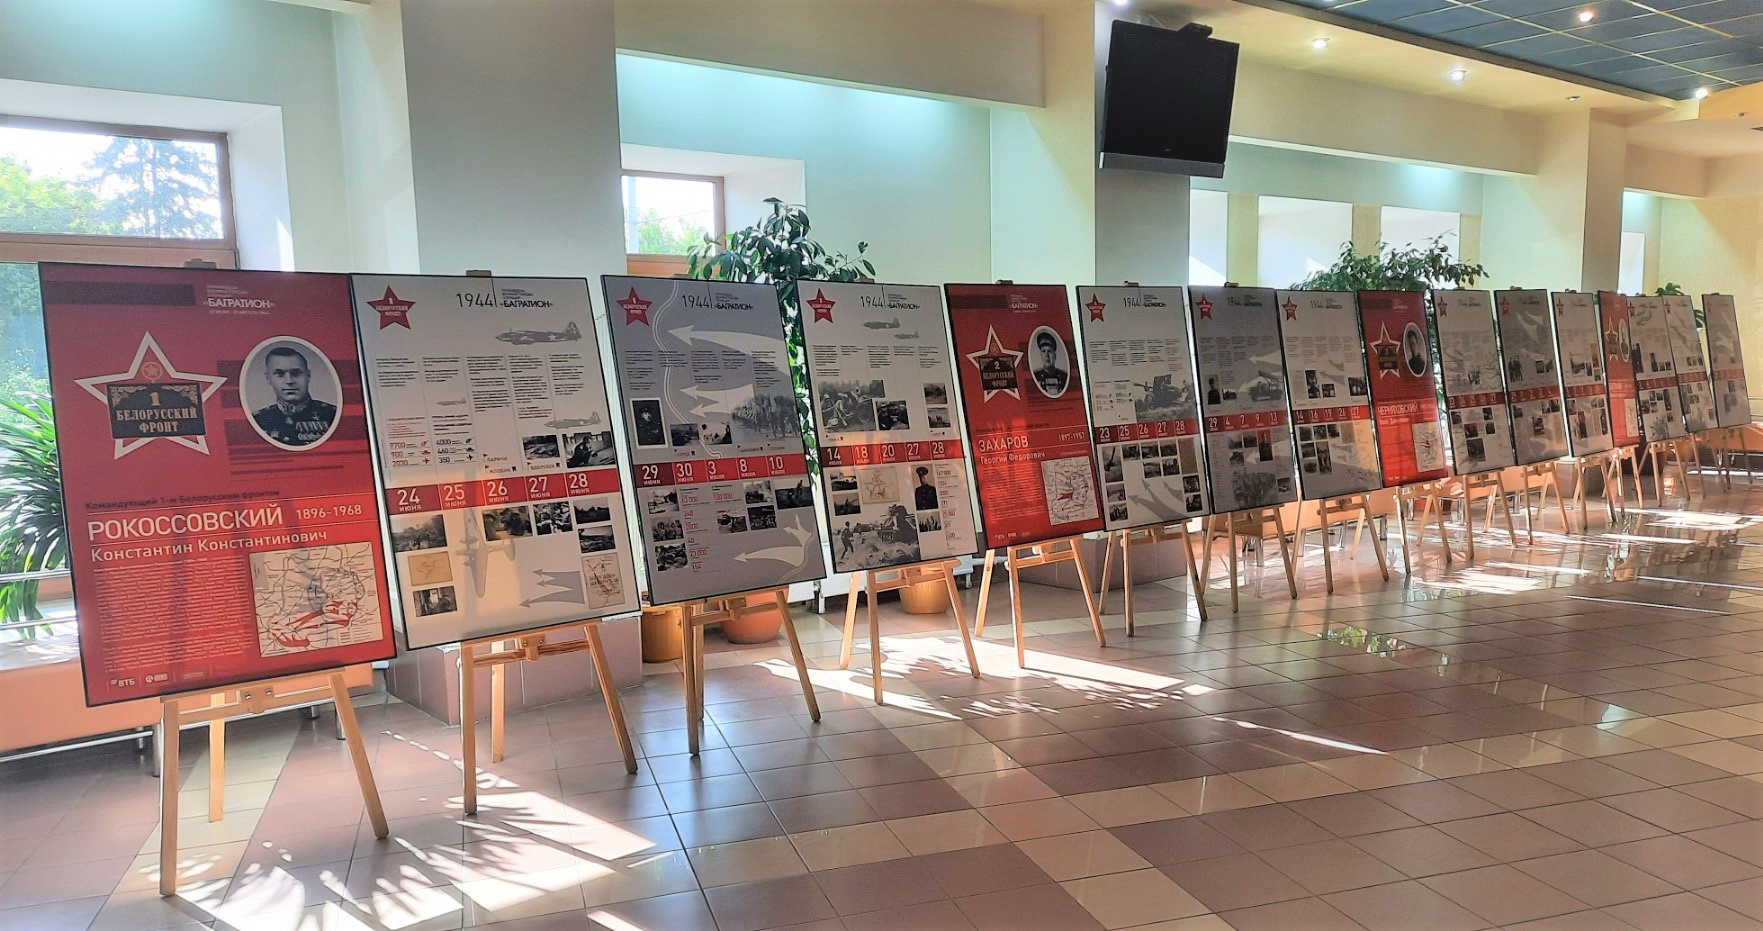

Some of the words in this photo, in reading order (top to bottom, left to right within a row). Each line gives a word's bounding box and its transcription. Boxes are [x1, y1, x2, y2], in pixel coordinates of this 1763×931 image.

[456, 293, 493, 307] 1944
[682, 295, 710, 308] 1944
[860, 295, 883, 308] 1944
[994, 361, 1000, 370] 2
[150, 392, 160, 406] 1
[116, 407, 197, 420] БЕЛОРУССКИЙ
[139, 421, 179, 433] ФРОНТ
[1139, 424, 1149, 434] 26
[1157, 422, 1167, 432] 27
[1175, 420, 1185, 431] 28
[1209, 418, 1217, 427] 29
[1100, 427, 1110, 438] 23
[1119, 426, 1130, 436] 25
[907, 443, 919, 456] 27
[932, 442, 945, 454] 28
[978, 435, 1029, 452] ЗАХАРОВ
[827, 447, 841, 460] 14
[855, 446, 868, 459] 18
[881, 444, 895, 458] 20
[739, 458, 748, 472] 8
[769, 456, 784, 470] 10
[980, 454, 1008, 465] Георгий
[641, 465, 659, 480] 29
[676, 462, 693, 477] 30
[708, 461, 717, 475] 3
[528, 477, 548, 493] 27
[568, 473, 589, 489] 28
[443, 484, 465, 501] 25
[487, 481, 508, 497] 26
[397, 487, 420, 506] 24
[85, 498, 159, 509] Командующий
[87, 504, 283, 541] РОКОССОВСКИЙ
[296, 504, 362, 520] 1896-1968
[91, 543, 193, 562] Константин
[198, 531, 327, 552] Константинович
[118, 678, 135, 687] ВТБ
